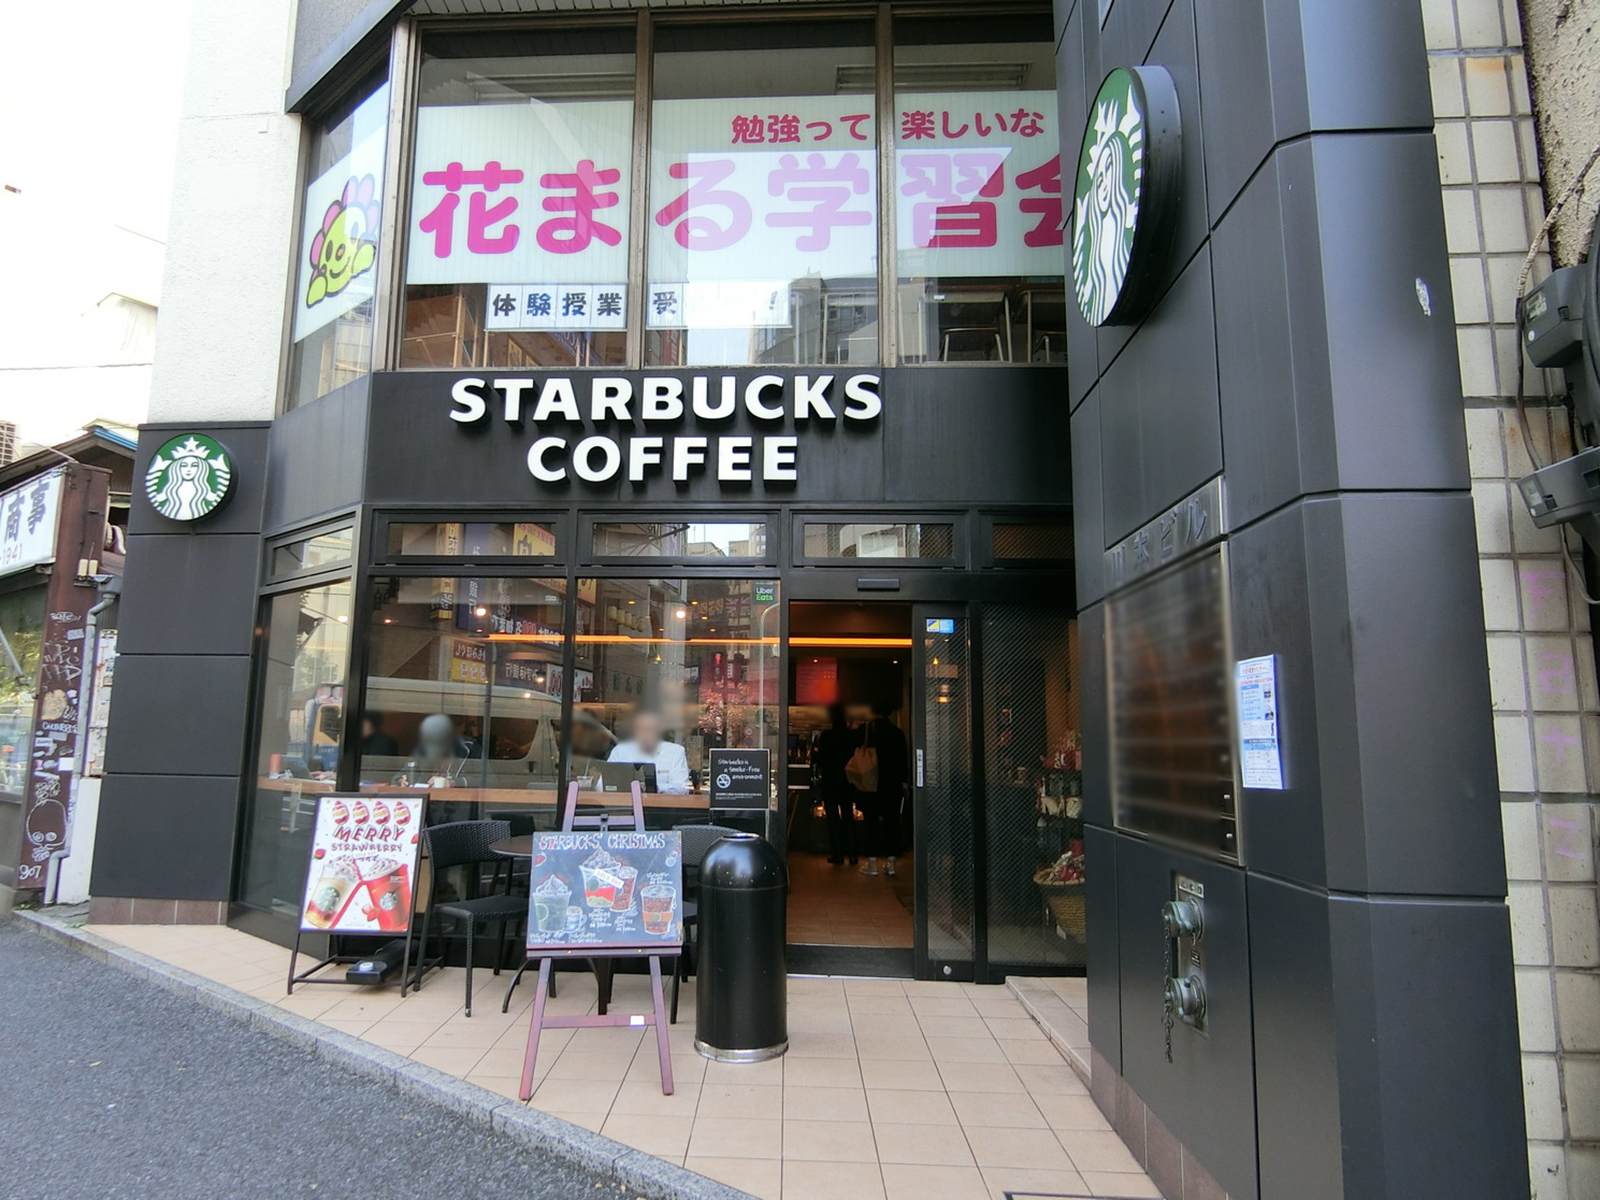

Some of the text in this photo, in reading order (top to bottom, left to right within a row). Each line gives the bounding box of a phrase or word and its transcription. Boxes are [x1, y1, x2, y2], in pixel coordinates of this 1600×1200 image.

[731, 108, 1045, 145] 勉強って 楽しいな
[492, 292, 624, 317] 体験授業
[449, 373, 884, 424] STARBUCKS
[526, 435, 799, 483] COFFEE
[0, 479, 50, 544] 商事
[331, 842, 403, 853] STRAWBERRY
[332, 823, 405, 843] MERRY
[607, 833, 666, 850] CHRISTMAS
